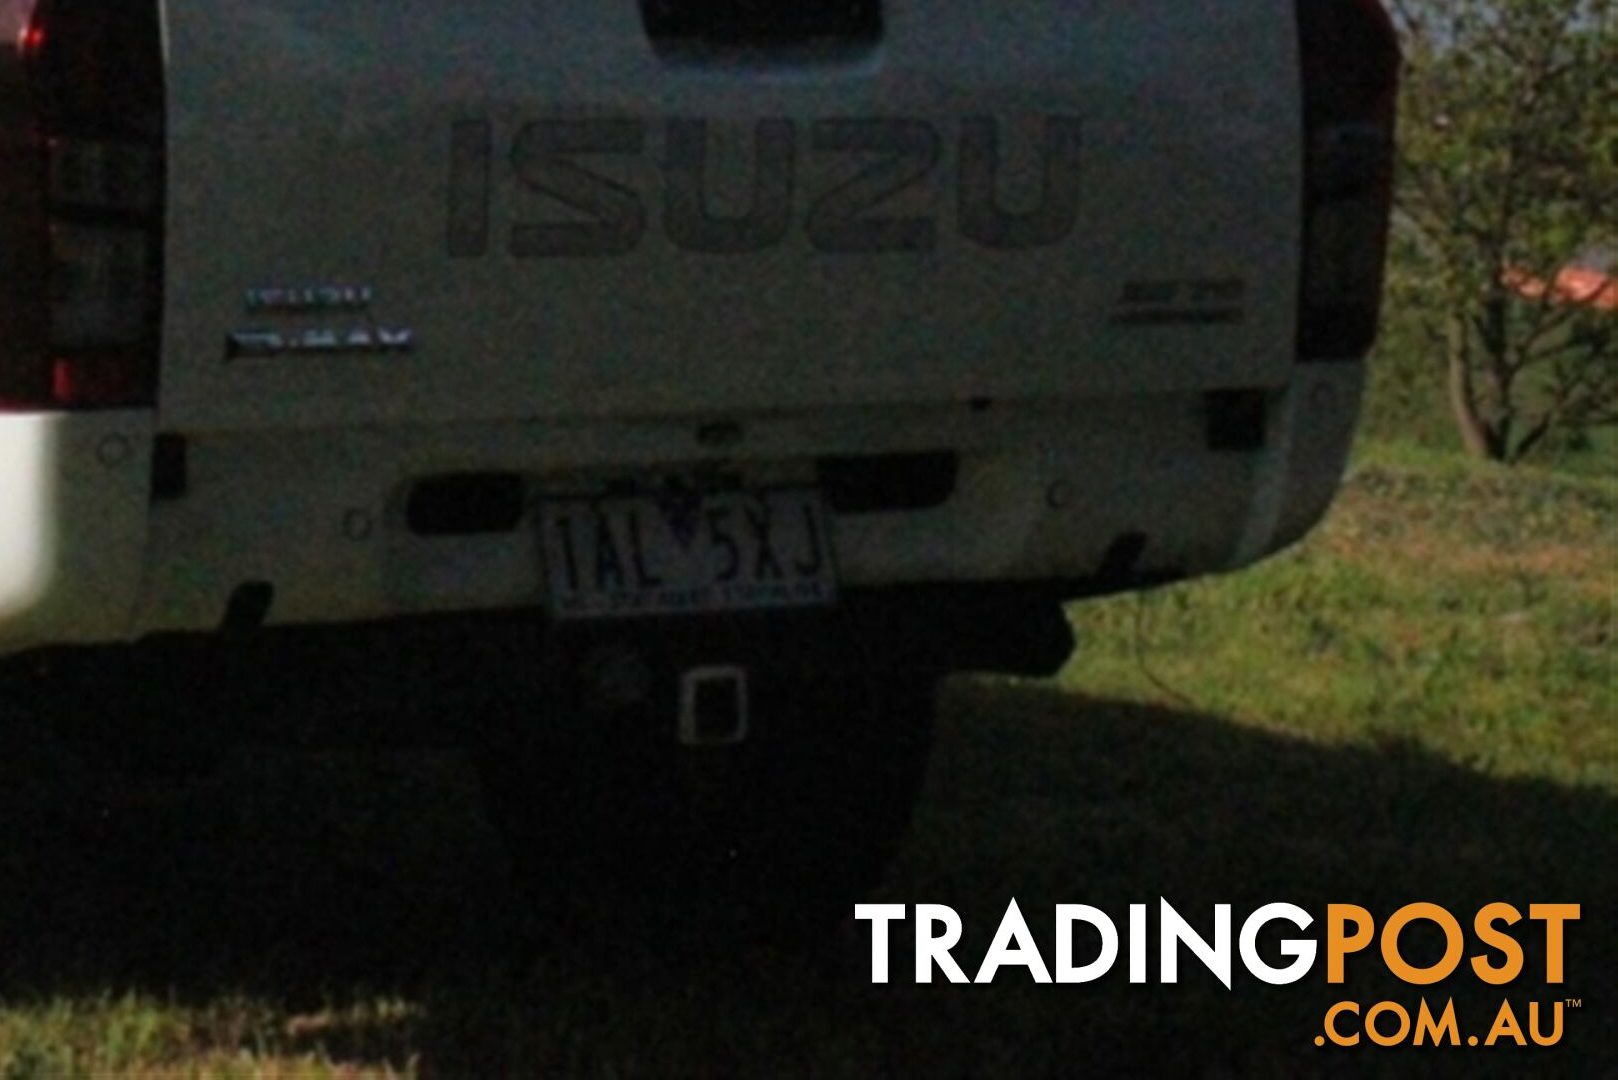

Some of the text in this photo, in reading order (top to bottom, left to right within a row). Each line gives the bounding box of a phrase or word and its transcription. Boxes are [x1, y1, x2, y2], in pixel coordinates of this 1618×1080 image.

[446, 114, 1084, 258] ISUZU
[554, 502, 823, 592] 1AL 5XJ
